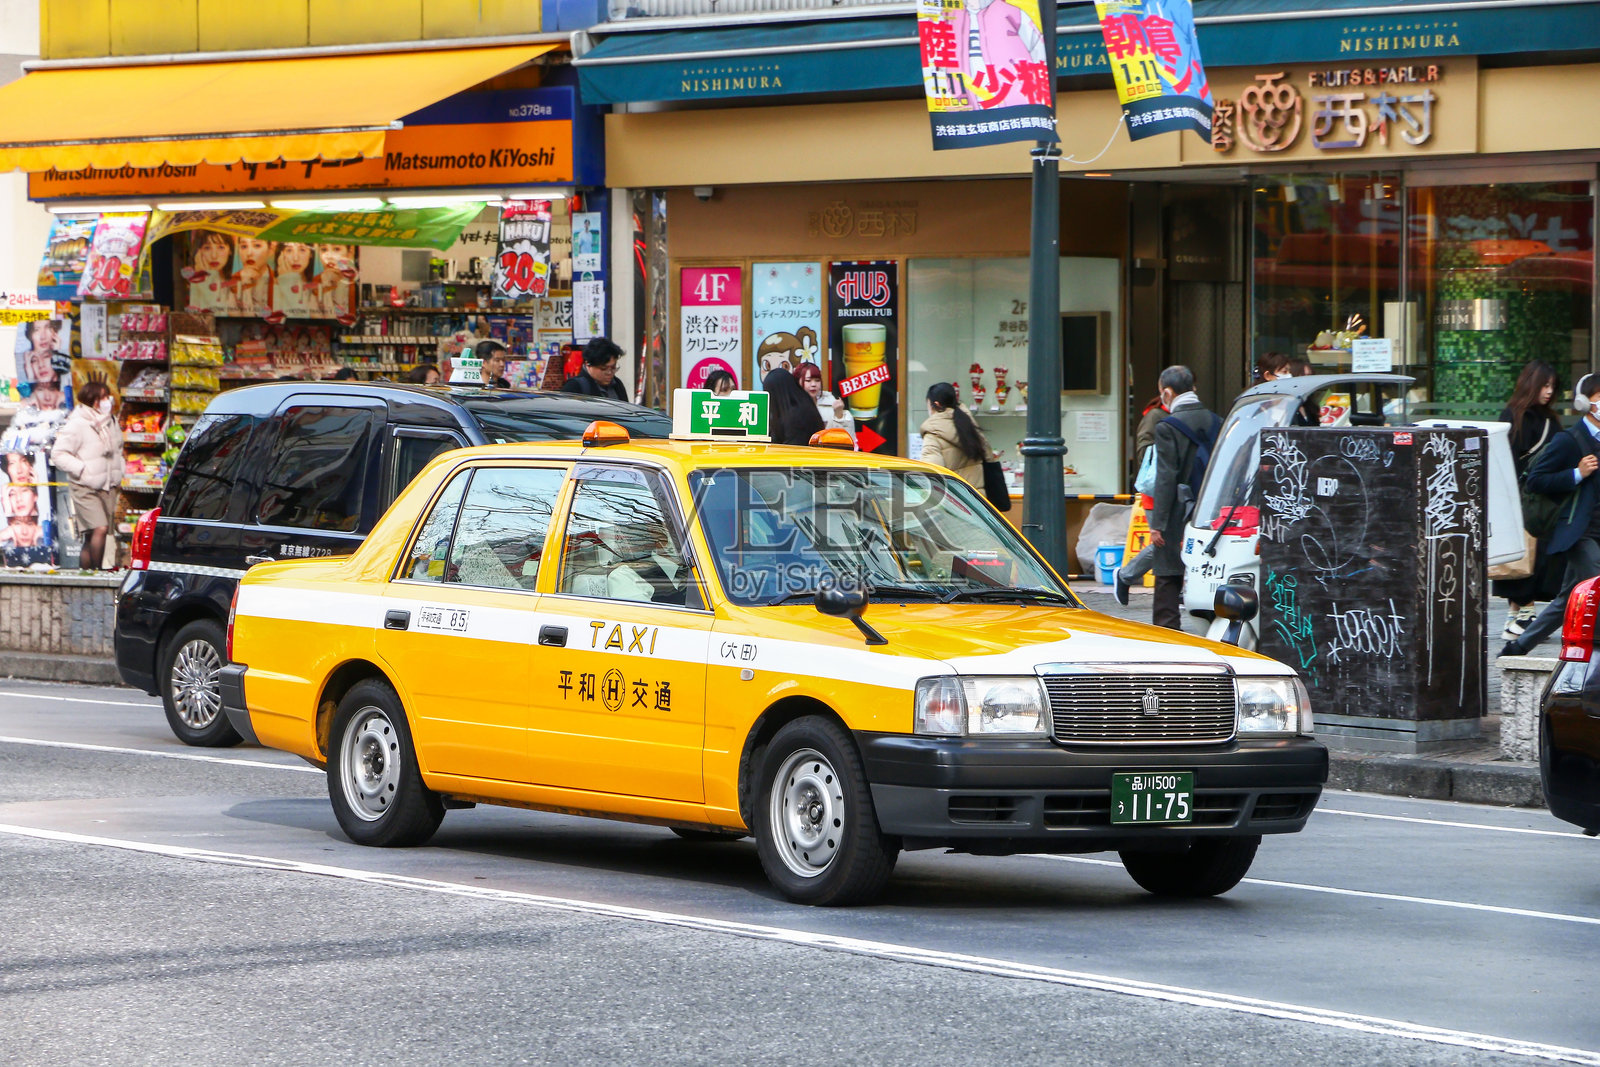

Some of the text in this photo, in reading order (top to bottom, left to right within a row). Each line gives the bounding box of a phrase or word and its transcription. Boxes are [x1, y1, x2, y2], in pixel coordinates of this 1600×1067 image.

[1340, 34, 1460, 53] NISHIMURA
[931, 72, 967, 95] 1.11
[1120, 60, 1160, 84] 1.11
[681, 76, 782, 92] NISHIMURA
[1312, 89, 1435, 149] 西村
[385, 151, 486, 170] Matsumoto
[489, 147, 555, 168] KiYoshi
[694, 273, 730, 302] 4F
[836, 271, 890, 308] HUB
[770, 295, 805, 305] ジャスミン
[1011, 299, 1028, 315] 2F
[686, 315, 718, 334] 渋谷
[754, 309, 821, 319] レディースクリニック
[838, 308, 893, 318] BRITISH PUB
[686, 337, 738, 352] クリニック
[463, 371, 480, 380] 2728
[840, 365, 890, 396] BEER!!
[700, 401, 759, 426] 平和
[450, 612, 467, 628] 85
[590, 621, 658, 655] TAXI
[558, 670, 595, 702] 平和
[631, 678, 672, 712] 交通
[1132, 792, 1190, 820] 11-75
